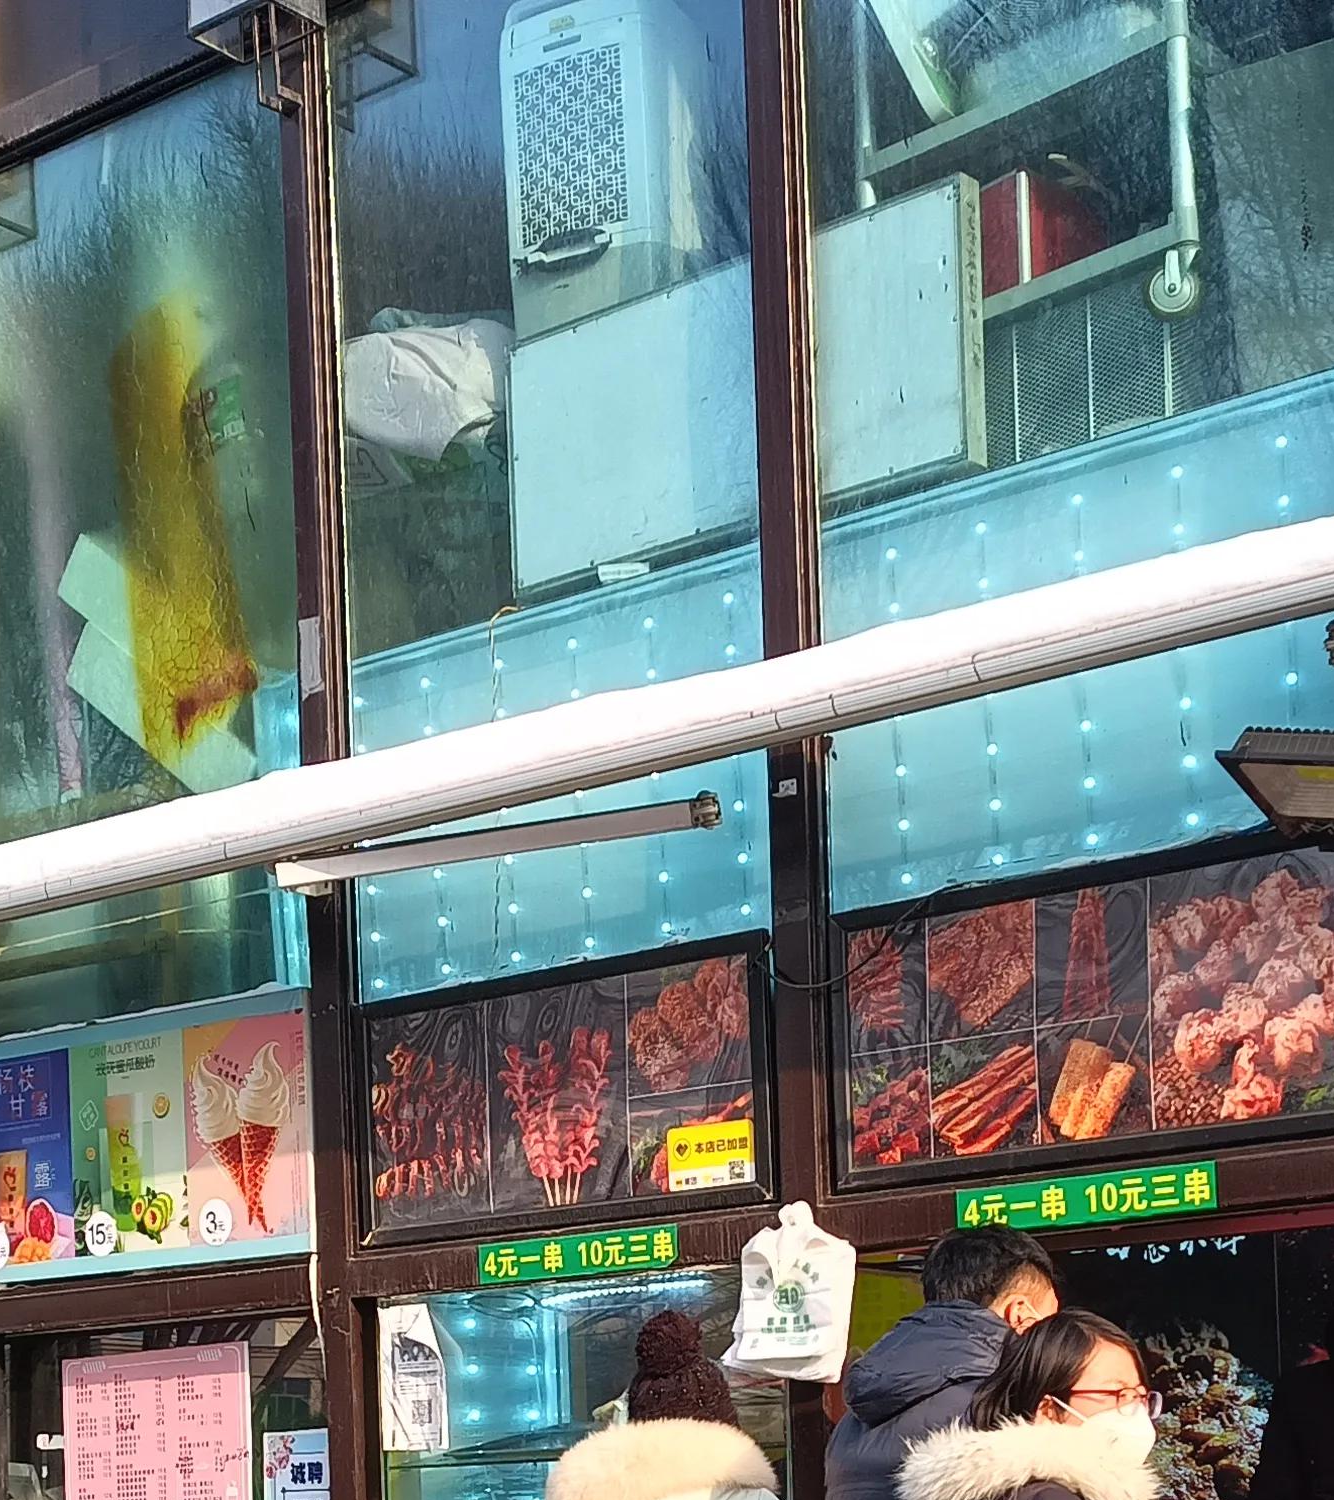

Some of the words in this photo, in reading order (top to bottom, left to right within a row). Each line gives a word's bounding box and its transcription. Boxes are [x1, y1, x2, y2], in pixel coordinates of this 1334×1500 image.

[694, 1136, 749, 1155] 本店已加盟
[964, 1185, 1067, 1226] 4元一串
[1084, 1169, 1211, 1213] 10元三串
[484, 1241, 564, 1278] 4元一串
[578, 1229, 675, 1267] 10元三串
[290, 1461, 323, 1485] 诚聘
